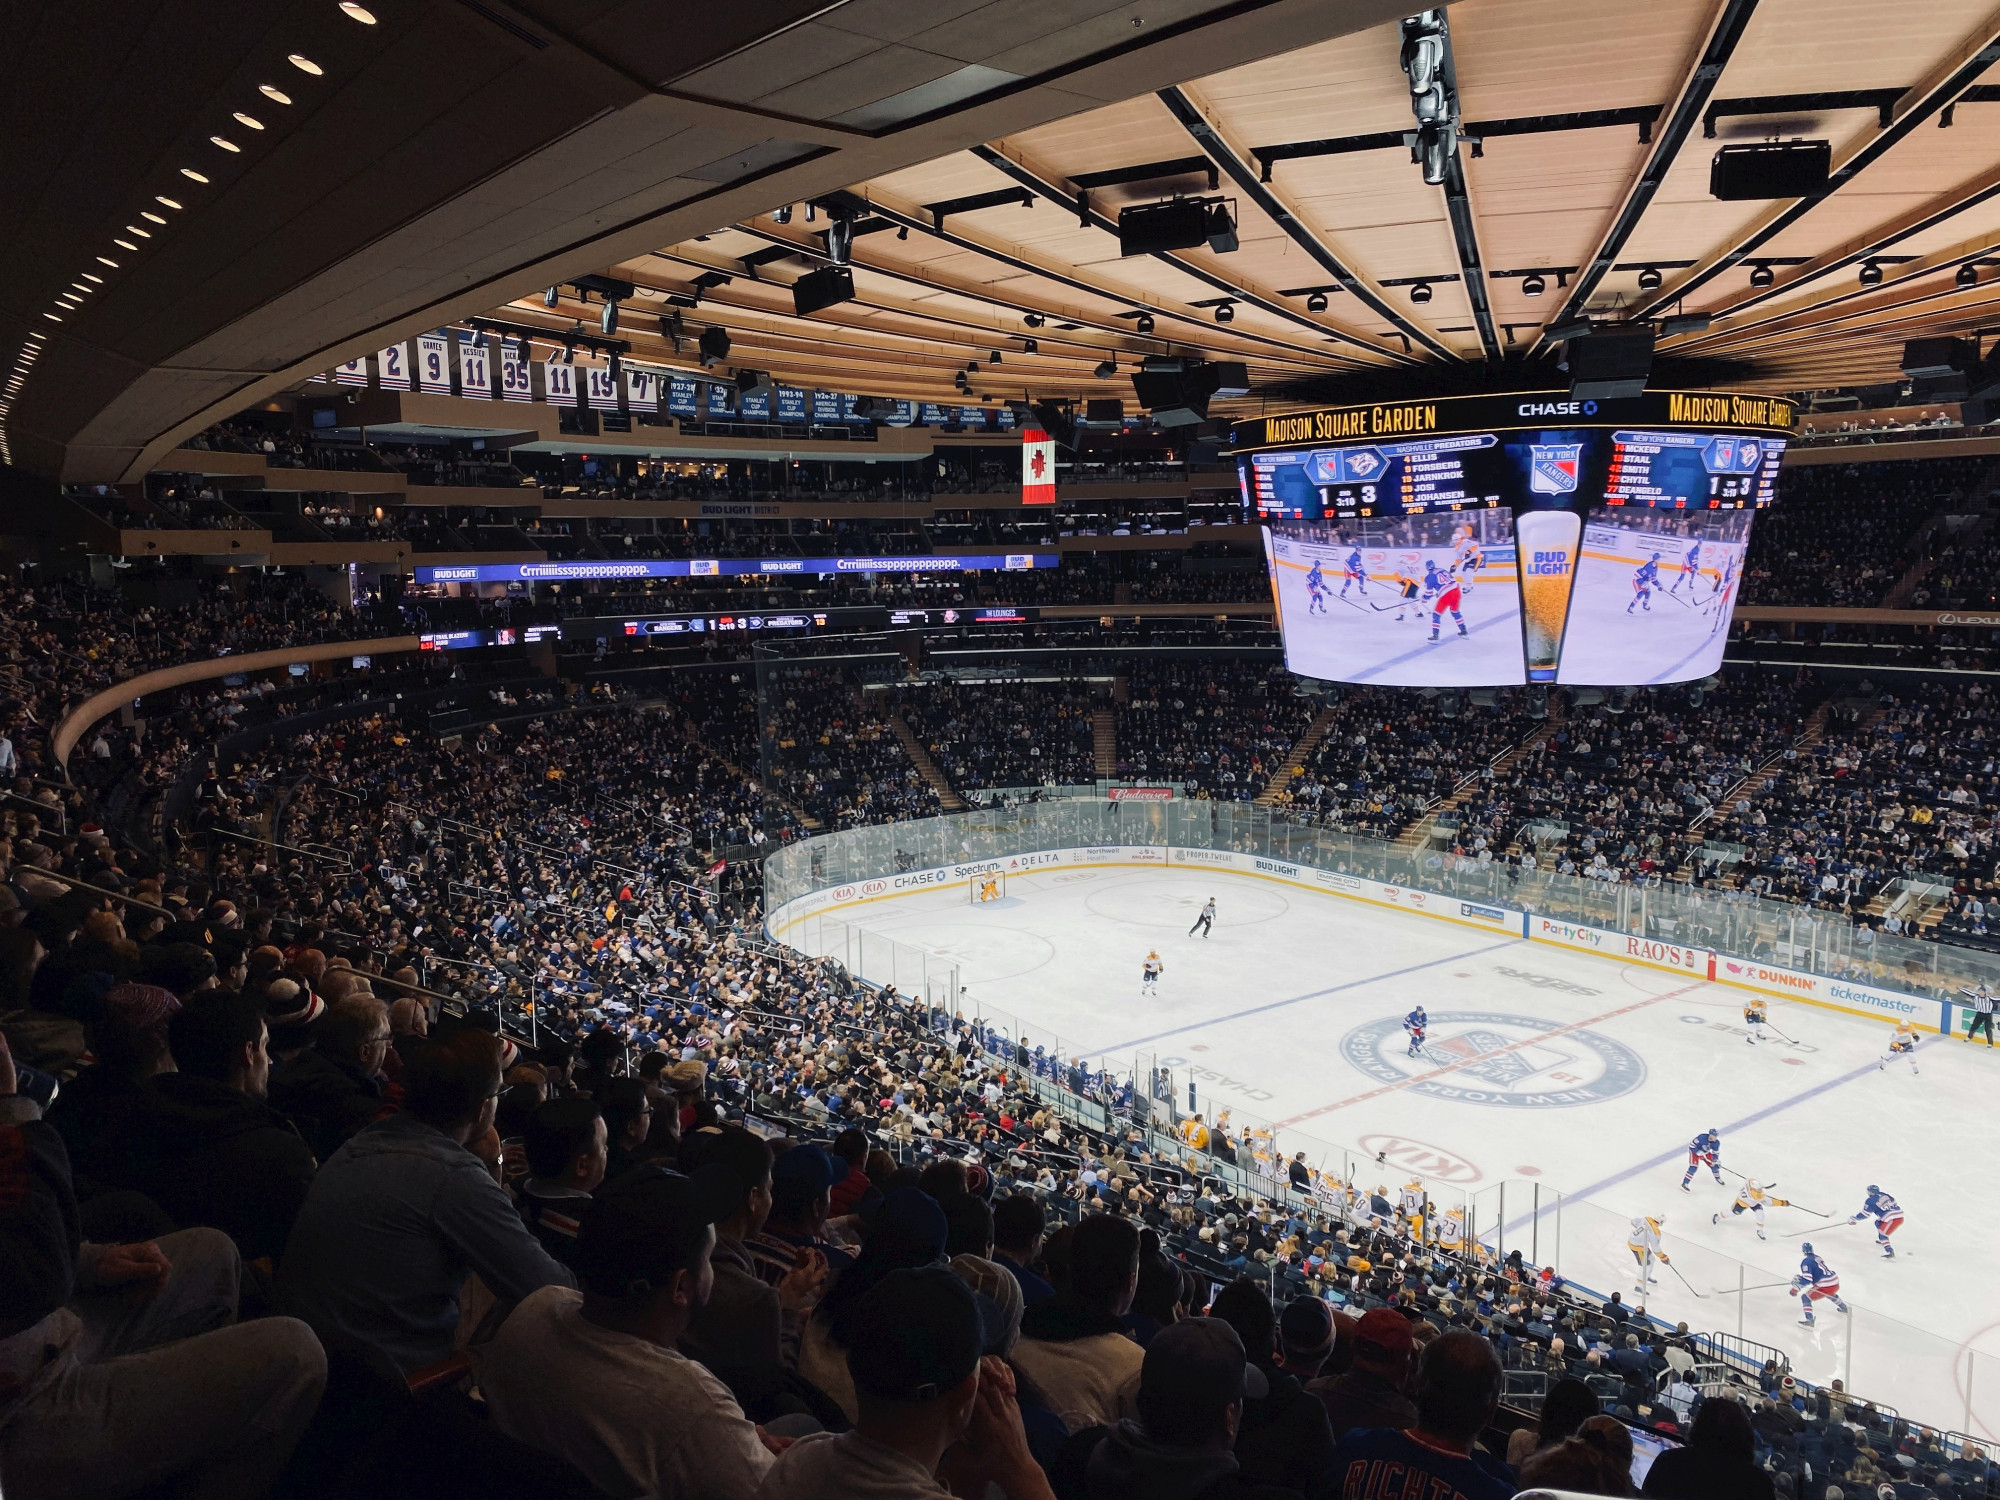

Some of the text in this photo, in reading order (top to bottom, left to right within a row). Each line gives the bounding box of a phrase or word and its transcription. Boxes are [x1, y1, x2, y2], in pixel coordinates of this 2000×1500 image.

[387, 347, 400, 376] 2
[428, 353, 440, 381] 9
[466, 359, 486, 387] 11
[504, 362, 529, 390] 35
[551, 368, 571, 394] 11
[591, 372, 613, 397] 19
[779, 390, 803, 398] 1993-94
[1518, 402, 1581, 416] CHASE
[1670, 394, 1729, 422] MADISON
[1732, 396, 1767, 425] SQUARE
[1266, 406, 1436, 443] MADISON SQUARE GARDEN
[1396, 439, 1482, 454] NASHVILLE PREDATORS
[1665, 437, 1695, 445] RANGERS
[1536, 450, 1576, 460] NEW YORK
[1625, 445, 1661, 454] MCKEGG
[1411, 454, 1438, 463] ELLIS
[1623, 455, 1651, 464] STAAL
[1412, 461, 1461, 472] FORSBERG
[1621, 465, 1650, 474] SMITH
[1413, 471, 1464, 482] JARNKROK
[1541, 463, 1574, 488] RANGERS
[1608, 475, 1650, 485] 72 CHYTIL
[1414, 483, 1435, 492] JOSI
[1606, 485, 1662, 495] 77 DEANGELO
[1710, 476, 1720, 495] 1
[1741, 478, 1751, 495] 3
[1319, 488, 1328, 505] 1
[1361, 486, 1376, 503] 3
[1415, 491, 1465, 502] JOHANSEN
[1336, 498, 1356, 507] 3:10
[1709, 500, 1720, 508] 27
[702, 505, 722, 514] BUD
[723, 505, 752, 514] LIGHT
[1323, 509, 1335, 518] 27
[1360, 508, 1372, 516] 13
[1533, 552, 1567, 563] BUD
[693, 567, 713, 575] LIGHT
[778, 562, 801, 570] LIGHT
[1527, 563, 1571, 575] LIGHT
[434, 569, 476, 579] BUD LIGHT
[709, 620, 716, 631] 1
[737, 618, 747, 629] 3
[767, 619, 803, 627] PREDATORS
[1957, 616, 2000, 625] LEXU
[625, 627, 637, 635] 27
[654, 624, 683, 632] RANGERS
[718, 623, 735, 631] 3:10
[1113, 788, 1169, 800] Budweiser
[1087, 847, 1120, 855] Northwell
[1186, 850, 1209, 859] PROPER
[1210, 852, 1232, 862] TWELVE
[1021, 853, 1060, 866] DELTA
[954, 861, 998, 878] Spectrum
[1256, 860, 1298, 877] BUD LIGHT
[895, 873, 934, 888] CHASE
[1318, 872, 1358, 886] EMPIRE CITY
[836, 888, 852, 898] KIA
[865, 883, 883, 893] KIA
[1626, 937, 1681, 965] RAO'S
[1830, 985, 1917, 1014] ticketmaster
[1351, 1031, 1403, 1081] RANGERS
[1182, 1064, 1275, 1102] CHASE
[1549, 1071, 1583, 1085] 19
[1414, 1084, 1596, 1105] NEW YORK
[1377, 1139, 1467, 1179] KIA
[1342, 1459, 1469, 1500] RICHT
